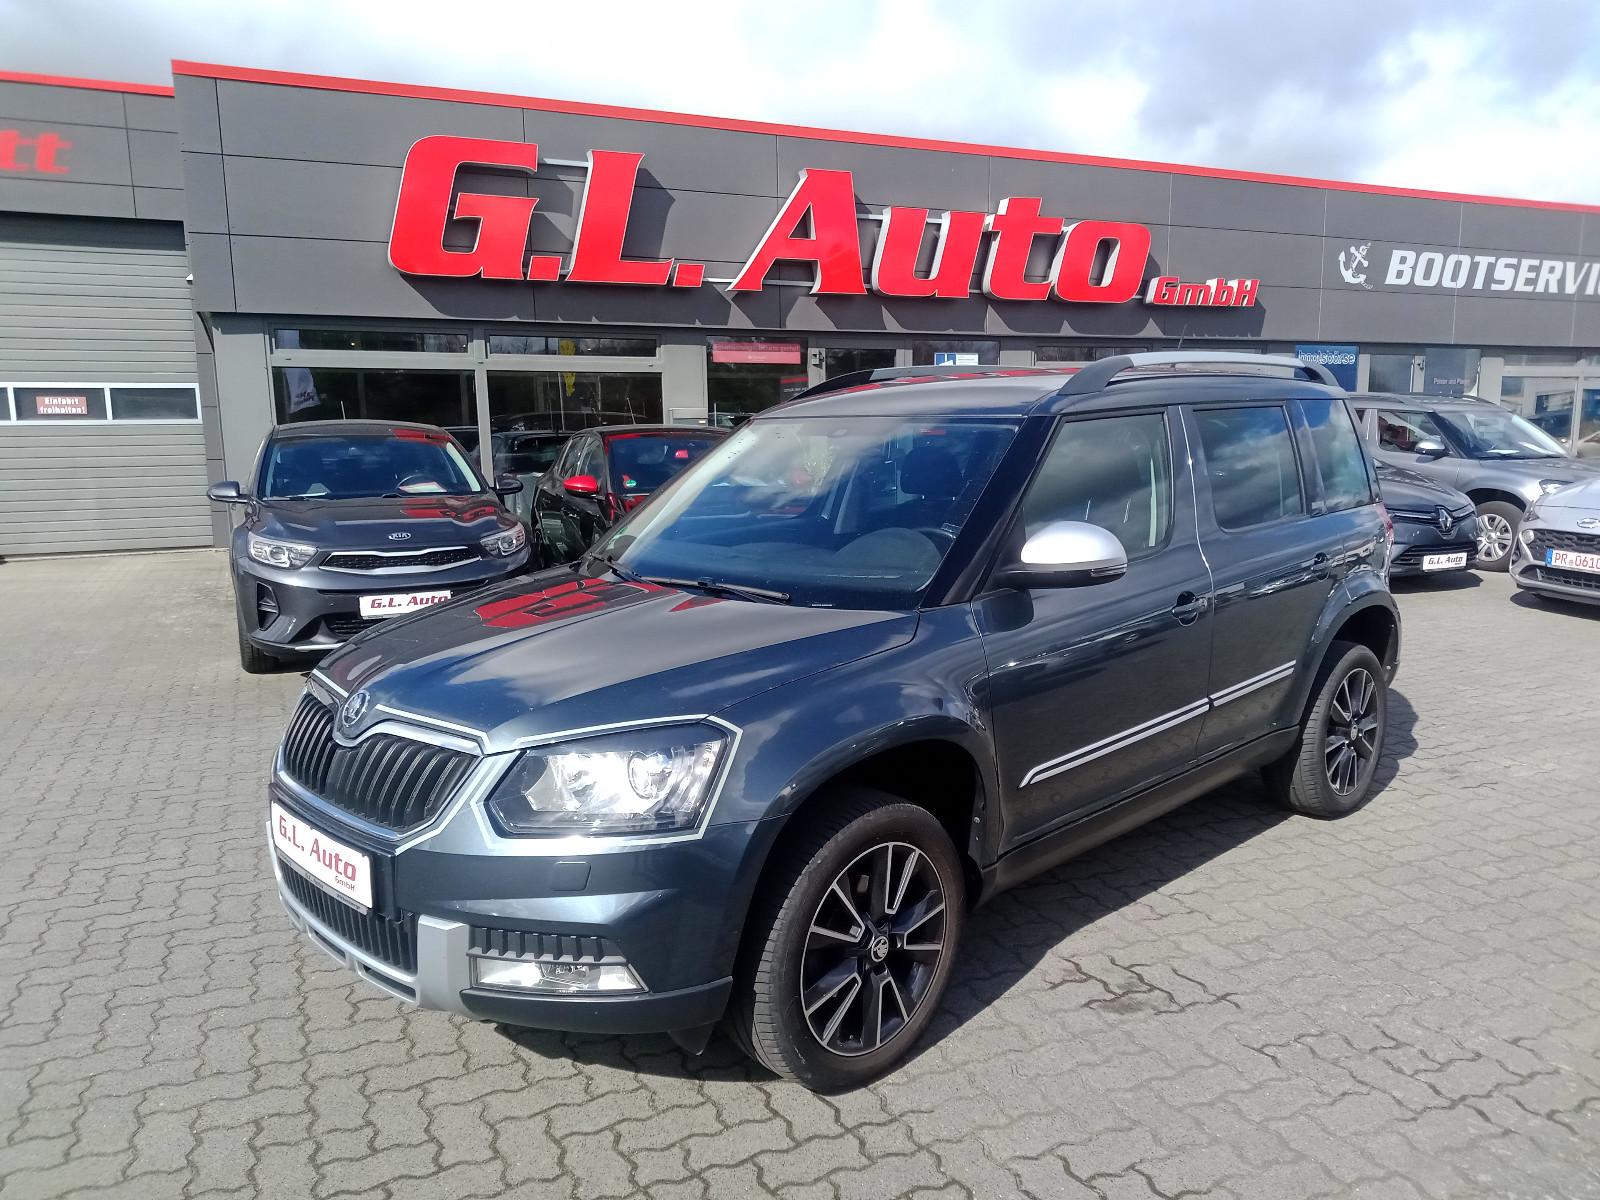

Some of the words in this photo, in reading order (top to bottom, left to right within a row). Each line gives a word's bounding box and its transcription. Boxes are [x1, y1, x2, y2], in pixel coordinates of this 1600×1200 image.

[388, 135, 705, 288] G.L.
[725, 166, 1152, 304] Auto
[1147, 276, 1260, 306] GmbH
[1384, 249, 1600, 295] BOOTSERVI
[1445, 555, 1464, 564] Auto
[1555, 552, 1568, 565] PR
[370, 598, 402, 609] G.L.
[279, 814, 305, 852] G.L.
[309, 838, 357, 882] Auto
[335, 875, 356, 892] GmbH
